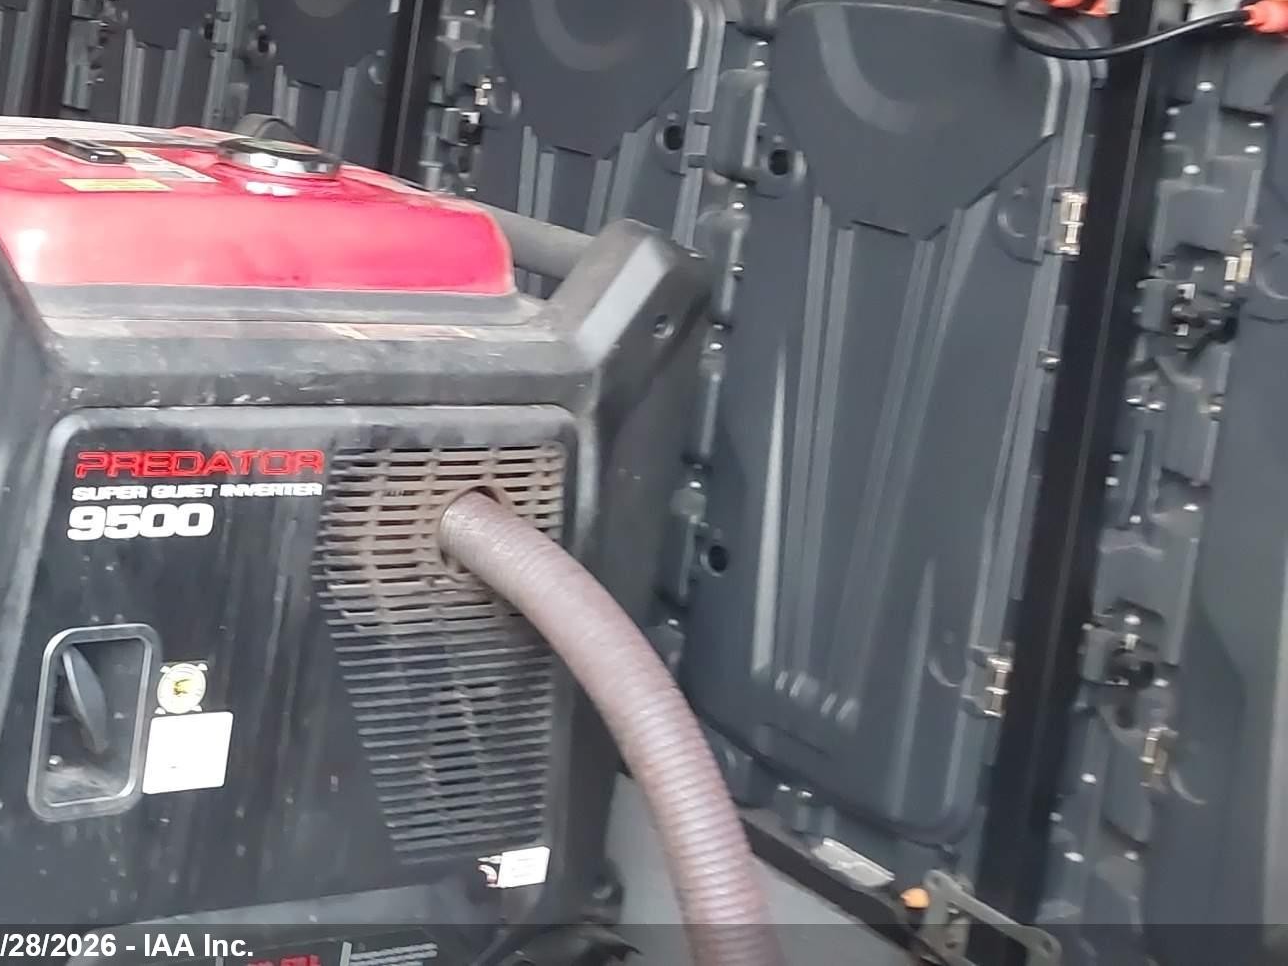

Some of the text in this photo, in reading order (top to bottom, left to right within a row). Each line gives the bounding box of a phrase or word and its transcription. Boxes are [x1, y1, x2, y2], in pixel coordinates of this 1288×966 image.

[75, 450, 326, 479] PREDATOR
[72, 484, 148, 501] SUPER
[219, 482, 324, 498] INVERTER
[67, 503, 215, 541] 9500
